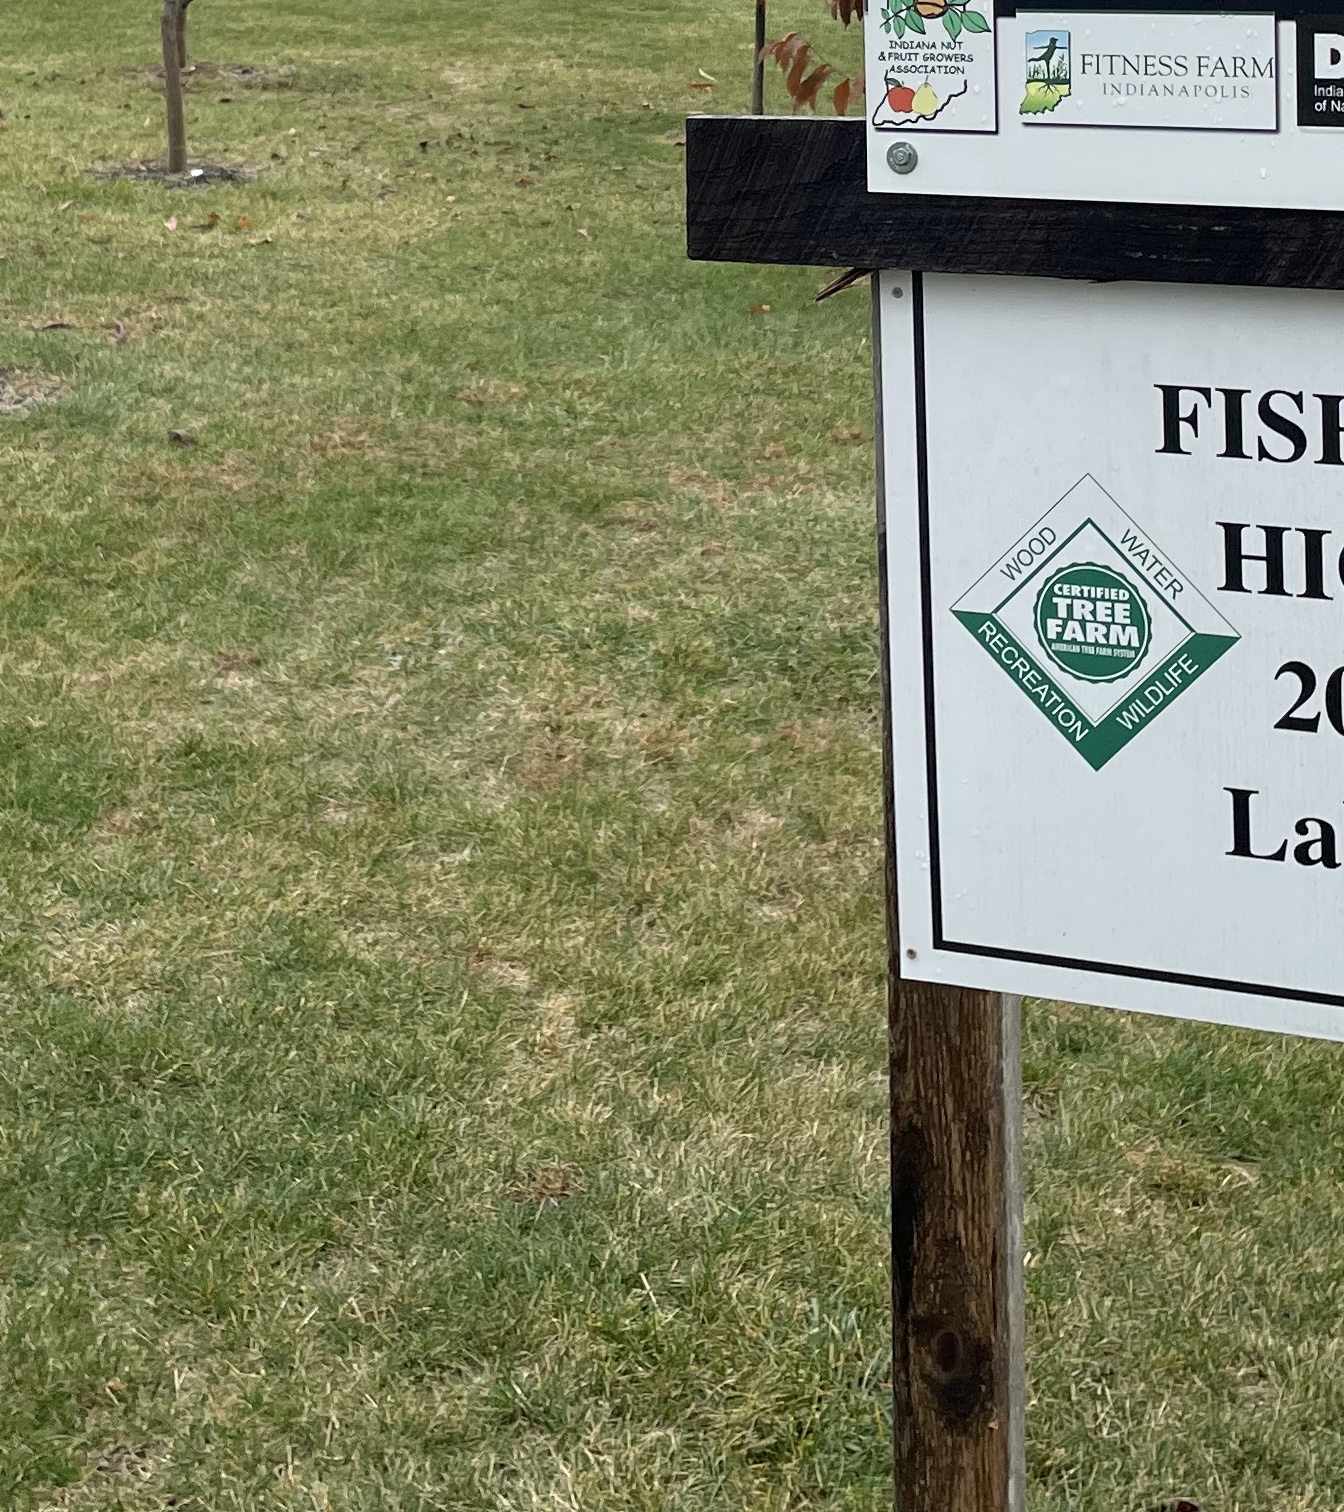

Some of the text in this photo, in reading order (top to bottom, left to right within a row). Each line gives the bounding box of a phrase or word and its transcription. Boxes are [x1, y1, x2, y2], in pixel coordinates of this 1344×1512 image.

[877, 51, 974, 63] & FRUIT GROWERS
[888, 40, 964, 51] INDIANA NUT
[888, 64, 965, 75] ASSOCIATION
[1080, 53, 1274, 79] FITNESS FARM
[1102, 82, 1251, 99] INDIANAPOLIS
[1314, 99, 1328, 112] of
[999, 525, 1058, 581] WOOD
[1119, 528, 1185, 601] WATER
[1053, 583, 1130, 601] CERTIFIED
[1051, 596, 1131, 624] TREE
[1046, 618, 1140, 648] FARM
[976, 619, 1090, 743] RECREATION
[1114, 652, 1200, 731] WILDLIFE
